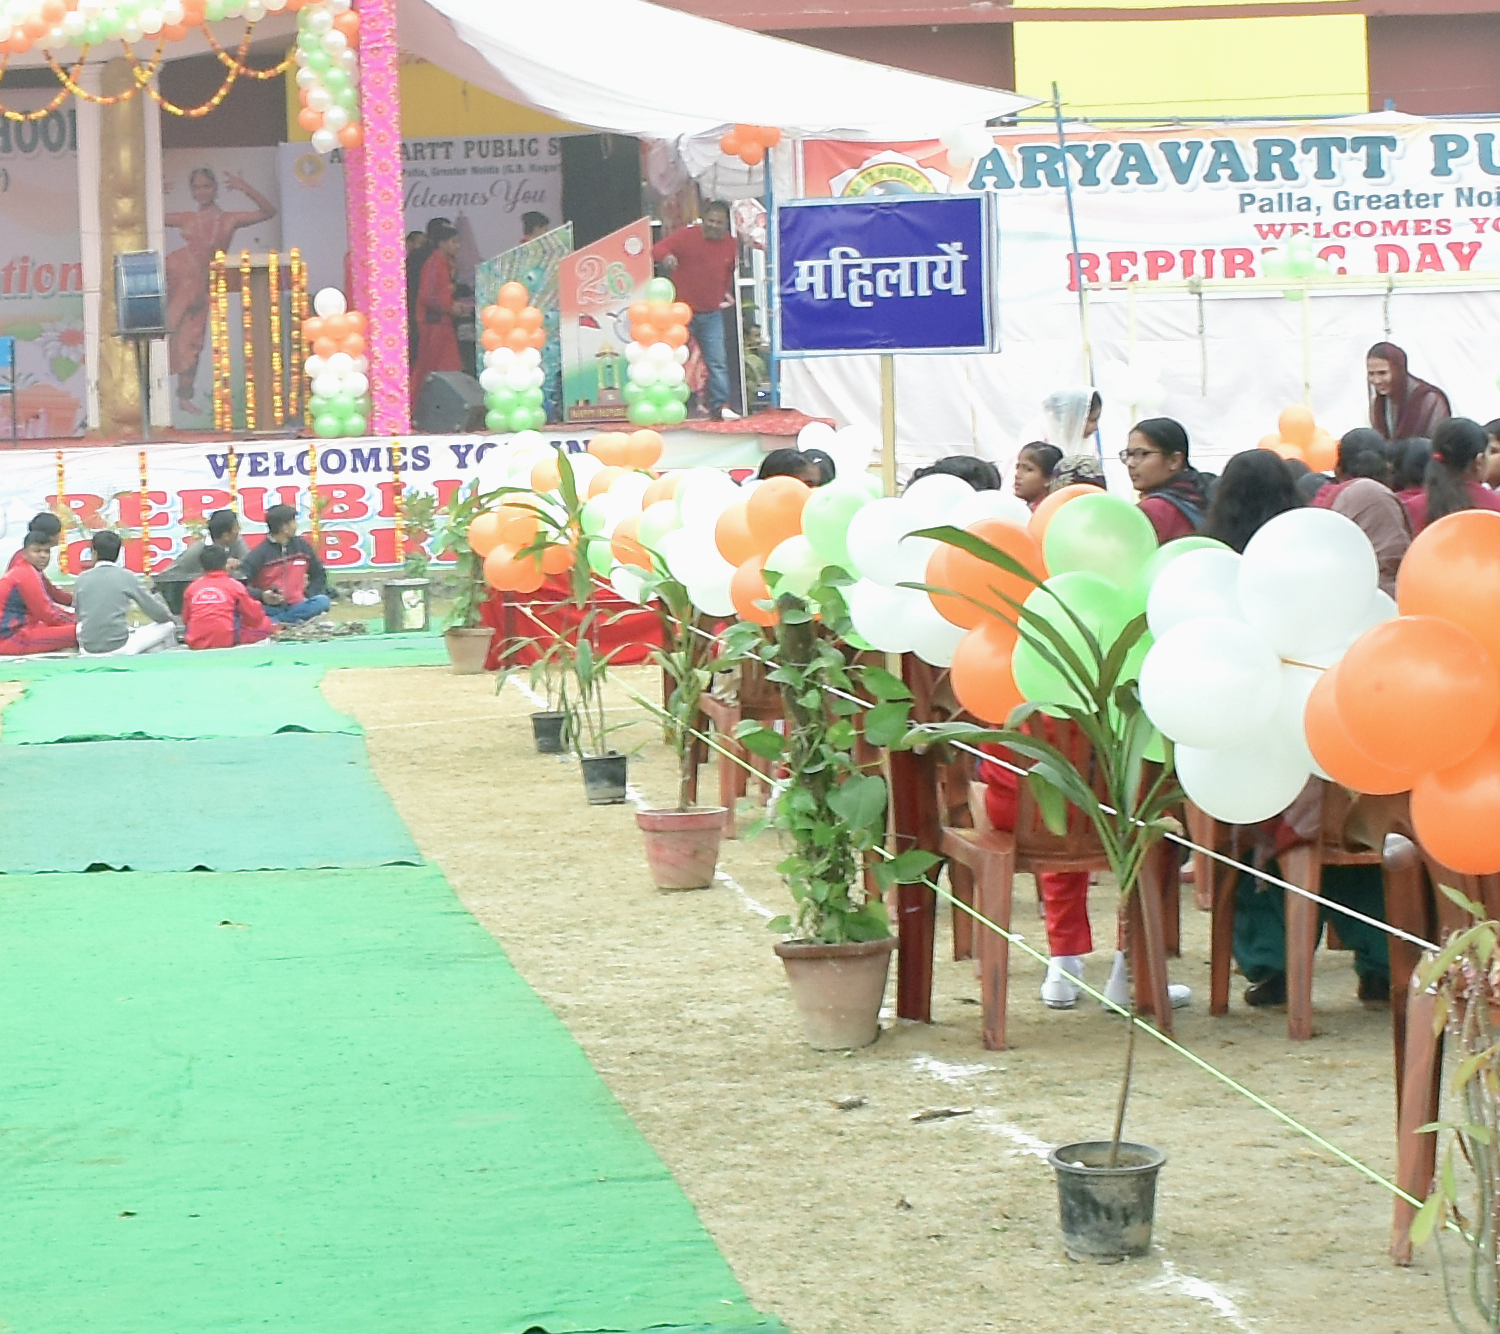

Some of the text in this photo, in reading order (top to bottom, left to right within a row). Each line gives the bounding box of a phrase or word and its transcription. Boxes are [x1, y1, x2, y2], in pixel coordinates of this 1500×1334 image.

[463, 138, 540, 159] PUBLIC
[967, 134, 1398, 190] ARYAVARTT
[488, 178, 547, 214] You
[1239, 192, 1322, 216] Palla,
[1333, 189, 1444, 212] Greater
[1253, 218, 1453, 241] WELCOMES
[574, 254, 635, 306] 26
[1065, 244, 1348, 291] REPUBC
[1374, 241, 1483, 275] DAY
[205, 444, 432, 480] WELCOMES
[44, 478, 482, 530] REPUBLI
